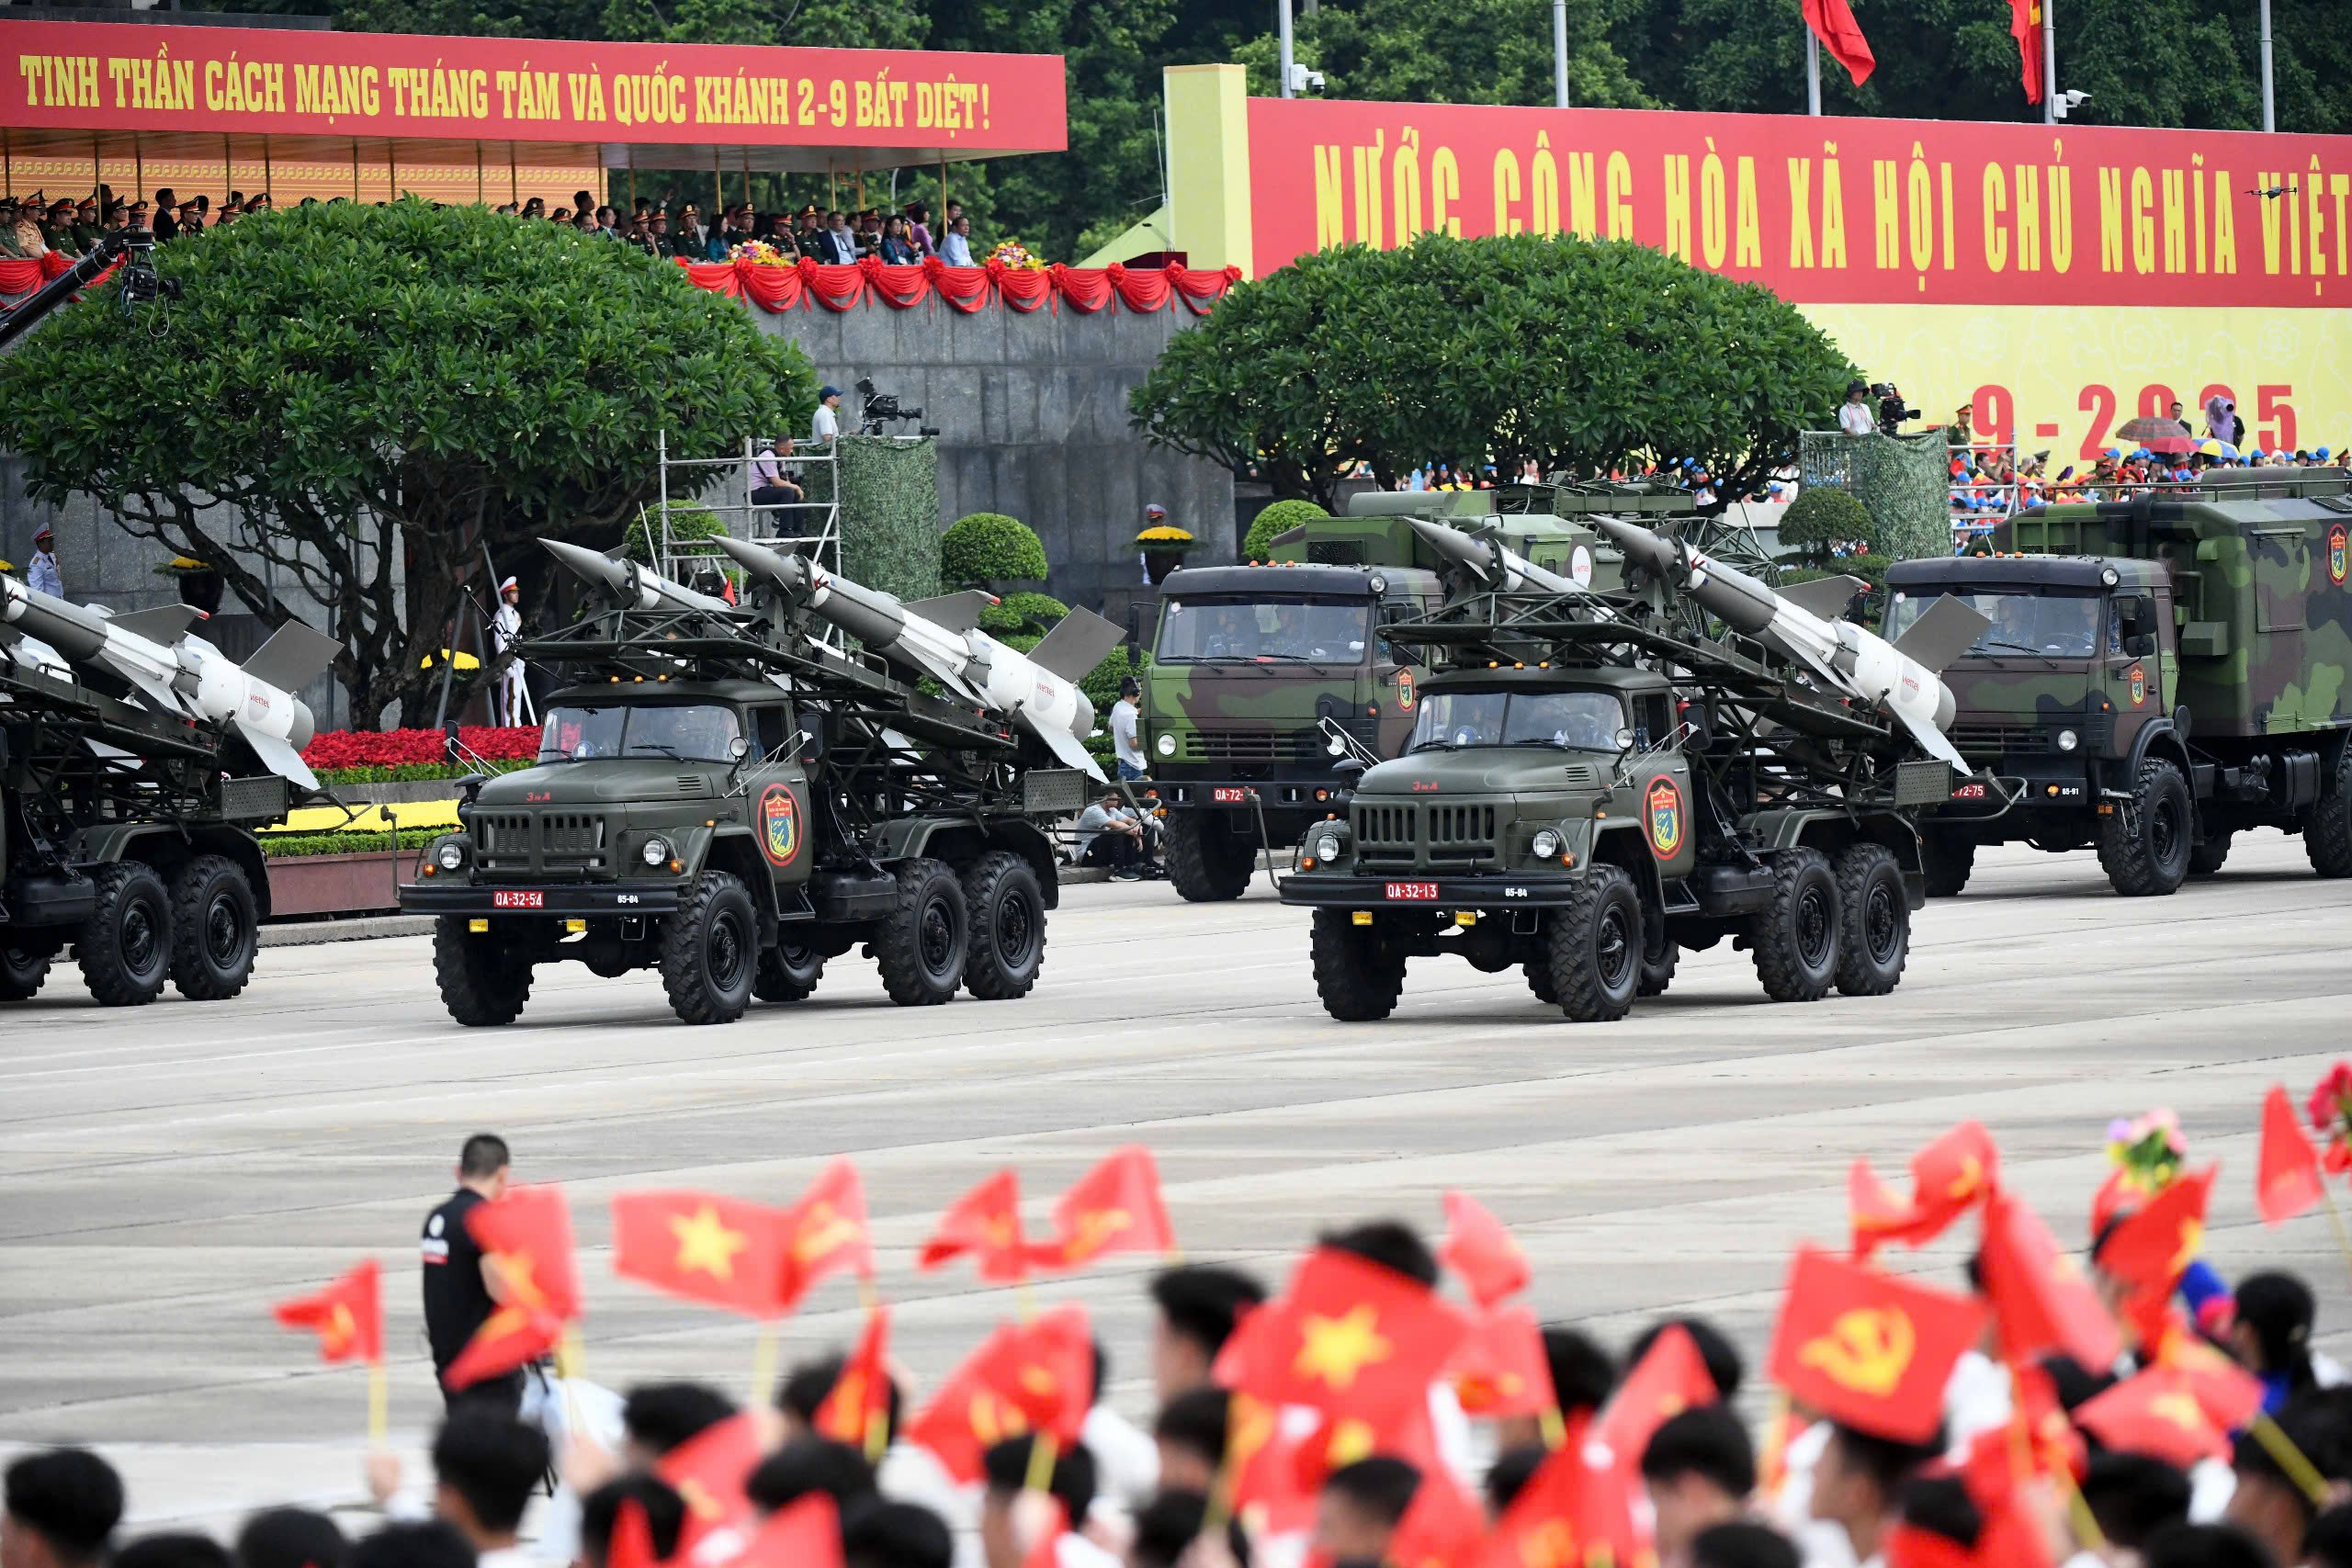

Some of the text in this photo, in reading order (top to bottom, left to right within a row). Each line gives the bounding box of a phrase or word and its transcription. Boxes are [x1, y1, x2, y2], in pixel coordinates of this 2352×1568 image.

[19, 42, 990, 139] TINH THẦN CÁCH MẠNG THÁNG TÁM VÀ QUỐC KHÁNH 2-9 BẤT DIỆT!
[1313, 125, 2350, 296] NƯỚC CÔNG HÒA XÃ HỘI CHỦ NGHĨA VIỆT
[617, 895, 639, 904] 65-84
[1505, 887, 1528, 897] 65-84
